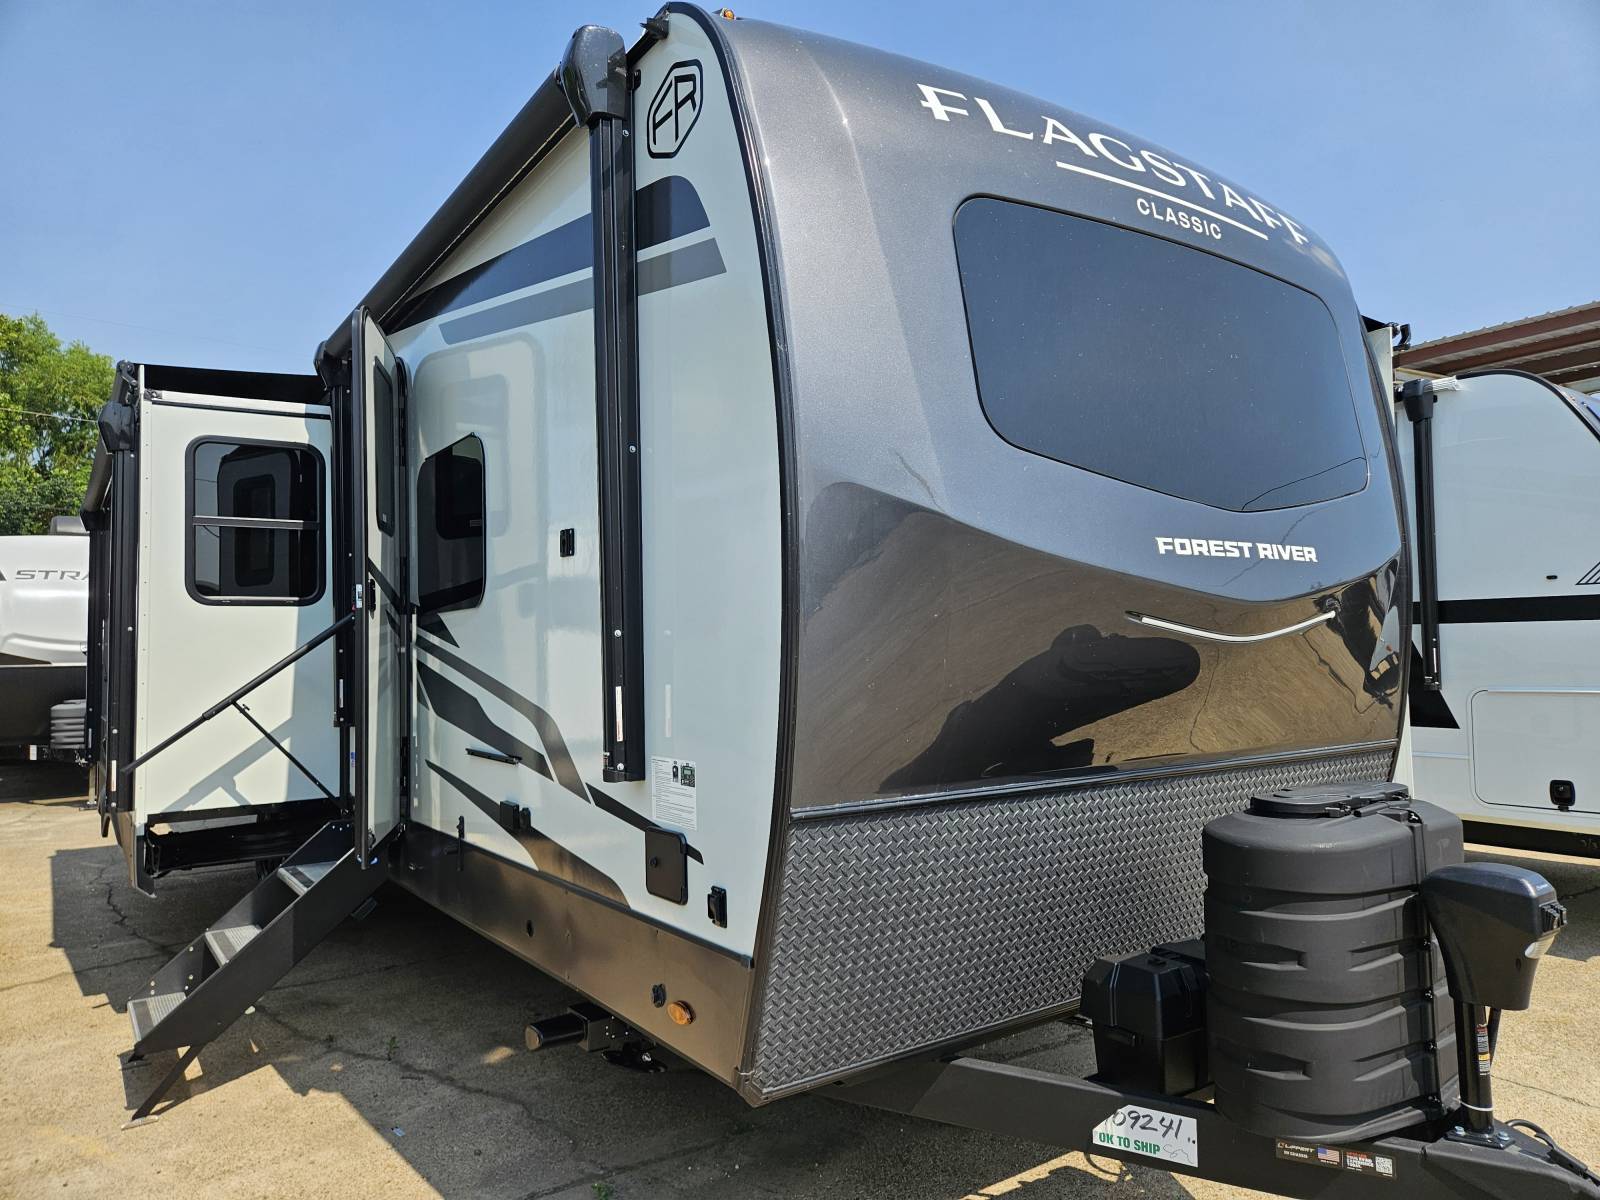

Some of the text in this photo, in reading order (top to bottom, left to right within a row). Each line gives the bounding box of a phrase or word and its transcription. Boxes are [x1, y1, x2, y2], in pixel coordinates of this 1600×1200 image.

[917, 83, 1310, 245] FLAGSTAFF
[1136, 198, 1223, 240] CLASSIC
[1155, 536, 1319, 563] FOREST RIVER
[1104, 1110, 1183, 1140] 09241
[1098, 1132, 1114, 1145] OK
[1116, 1135, 1131, 1148] TO
[1133, 1139, 1161, 1155] SHIP
